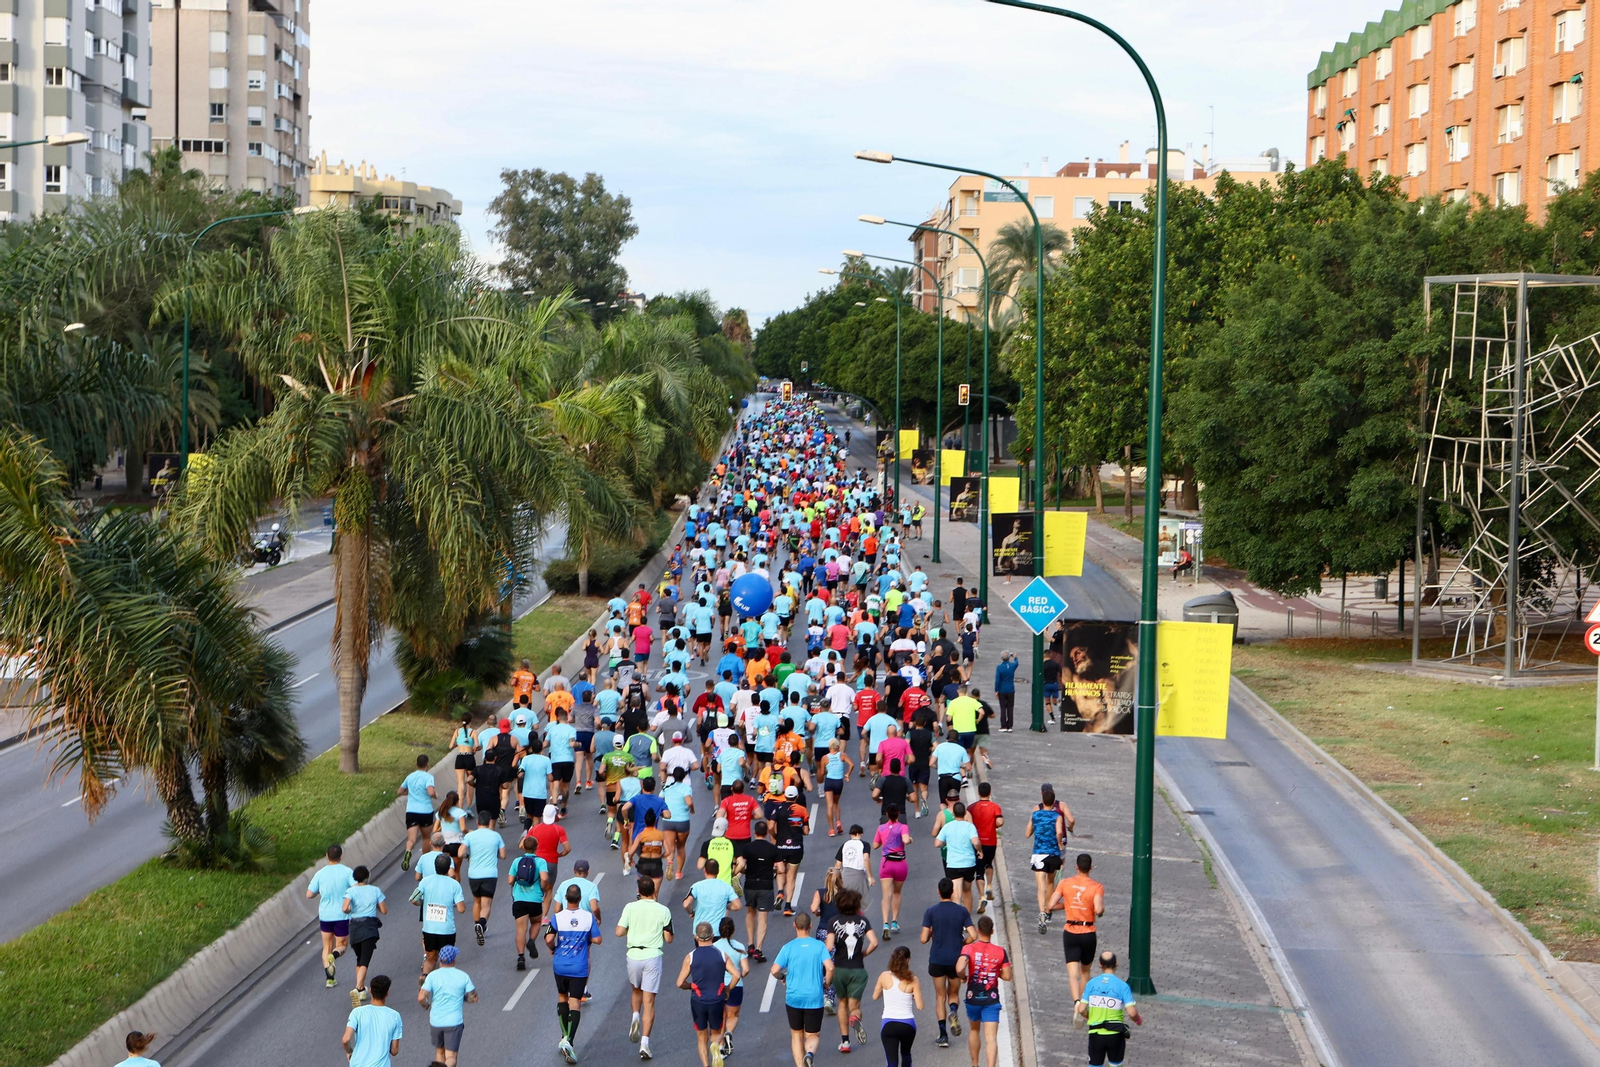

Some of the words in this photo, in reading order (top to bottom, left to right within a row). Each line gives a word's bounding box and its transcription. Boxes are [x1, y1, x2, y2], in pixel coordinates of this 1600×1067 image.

[1028, 596, 1048, 604] RED
[1020, 604, 1056, 614] BÁSICA
[1091, 996, 1116, 1008] CAO
